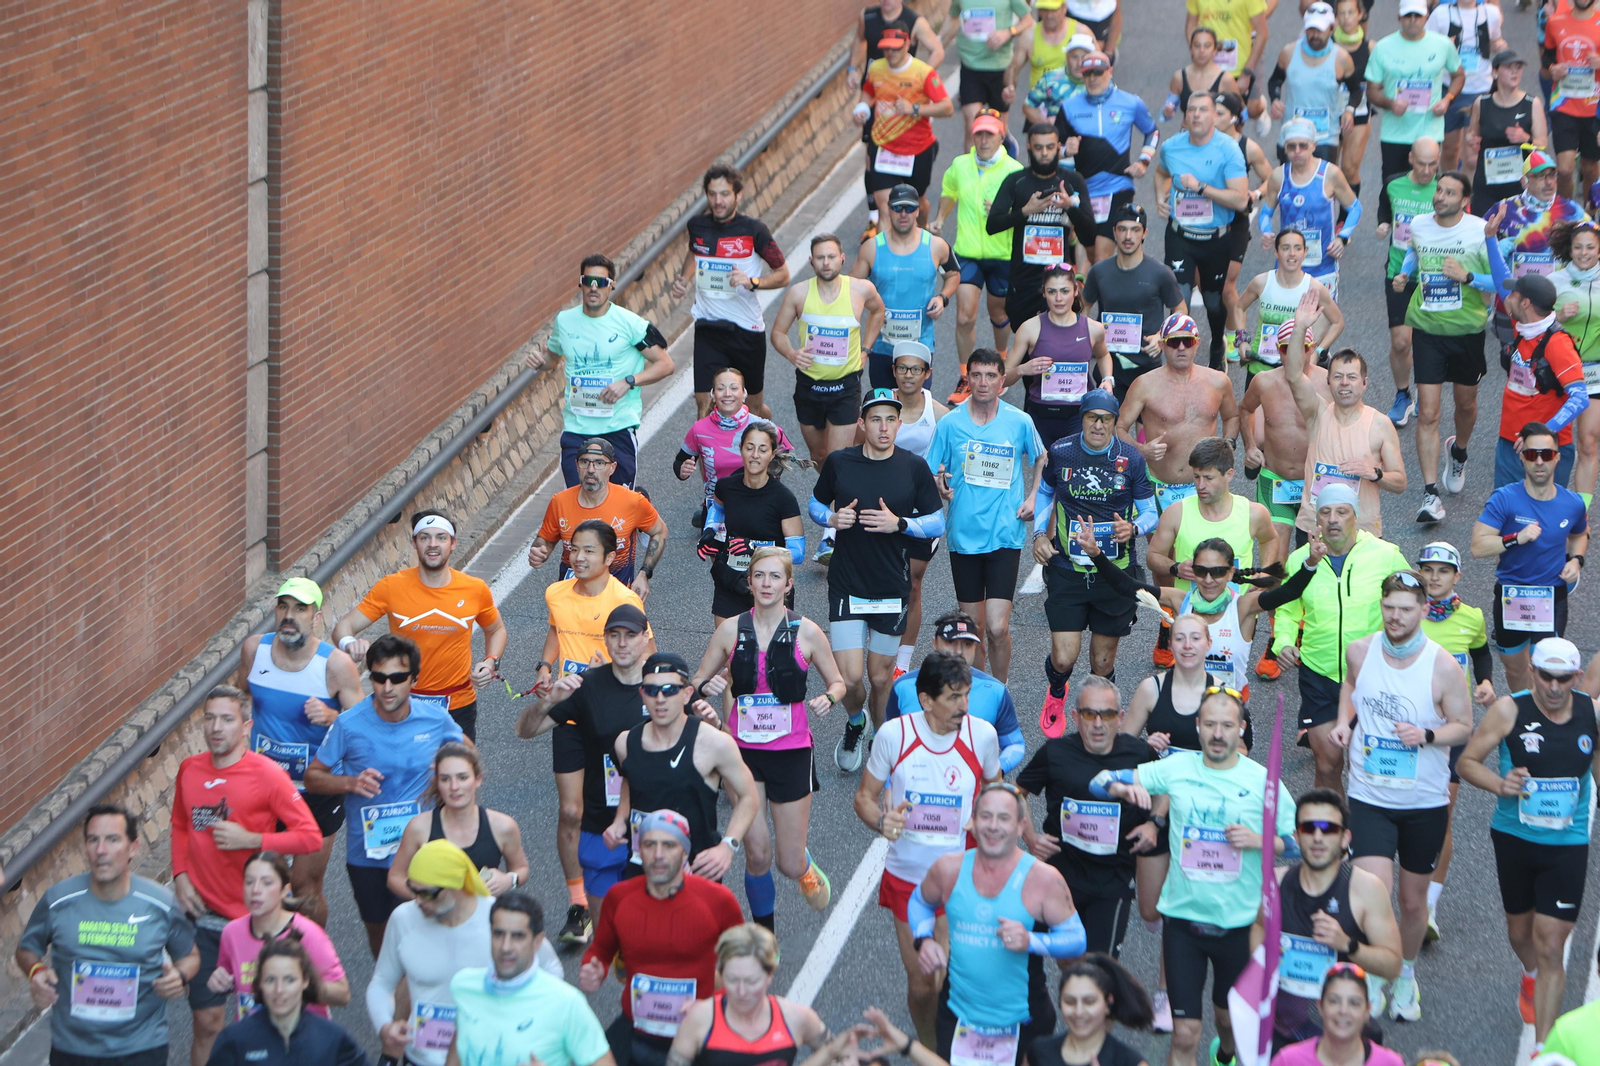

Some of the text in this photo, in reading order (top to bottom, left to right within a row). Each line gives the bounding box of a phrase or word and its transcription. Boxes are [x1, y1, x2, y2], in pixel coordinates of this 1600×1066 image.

[711, 263, 733, 271] ZURICH
[829, 383, 845, 393] MAX
[985, 446, 1010, 456] ZURICH
[981, 460, 1000, 470] 10162
[1069, 484, 1114, 497] Winner
[756, 713, 773, 721] 7564
[272, 745, 301, 756] ZURICH
[1540, 781, 1573, 791] ZURICH
[924, 796, 956, 806] ZURICH
[381, 806, 413, 818] ZURICH
[1081, 805, 1113, 816] ZURICH
[922, 813, 941, 821] 7058
[914, 823, 948, 832] LEONARDO
[95, 966, 130, 977] ZURICH
[654, 982, 688, 994] ZURICH
